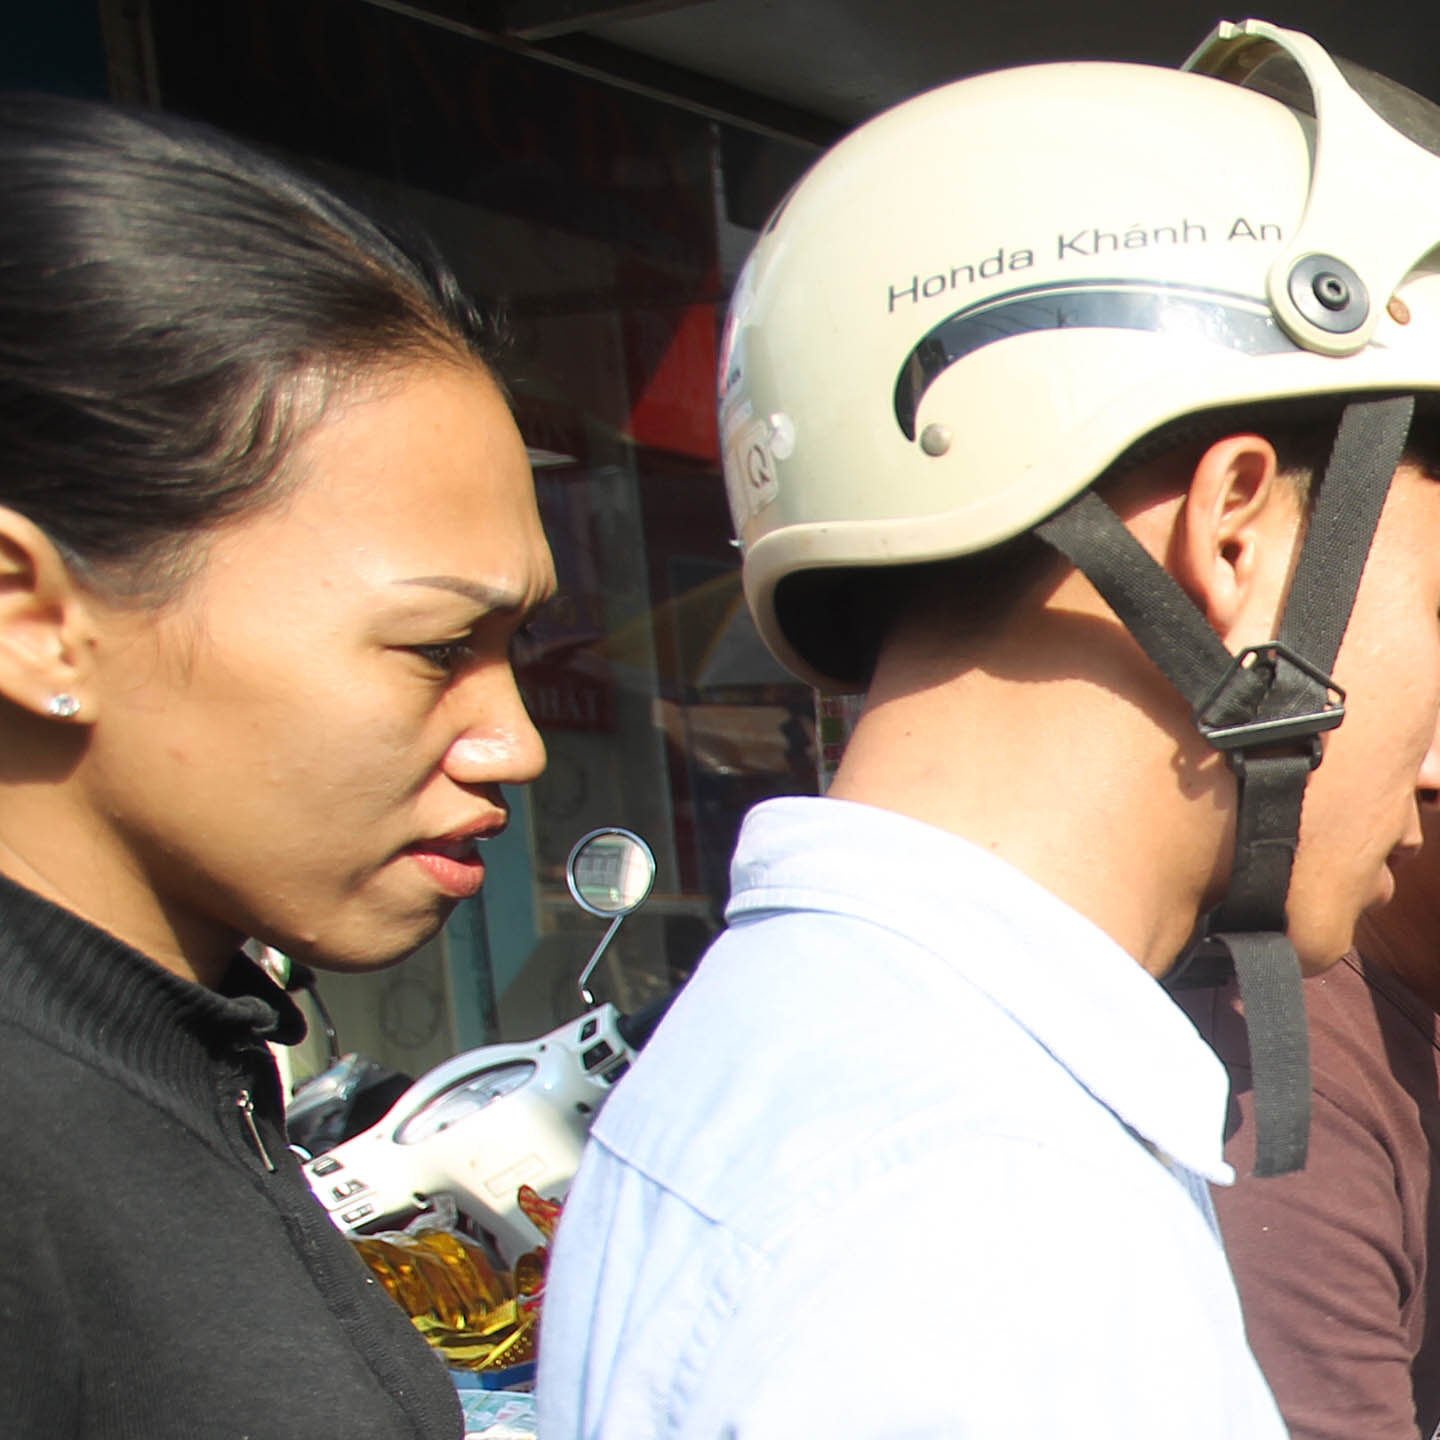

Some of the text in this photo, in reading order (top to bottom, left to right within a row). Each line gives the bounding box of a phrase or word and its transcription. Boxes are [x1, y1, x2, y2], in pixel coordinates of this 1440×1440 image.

[885, 217, 1283, 314] Honda Khánh An
